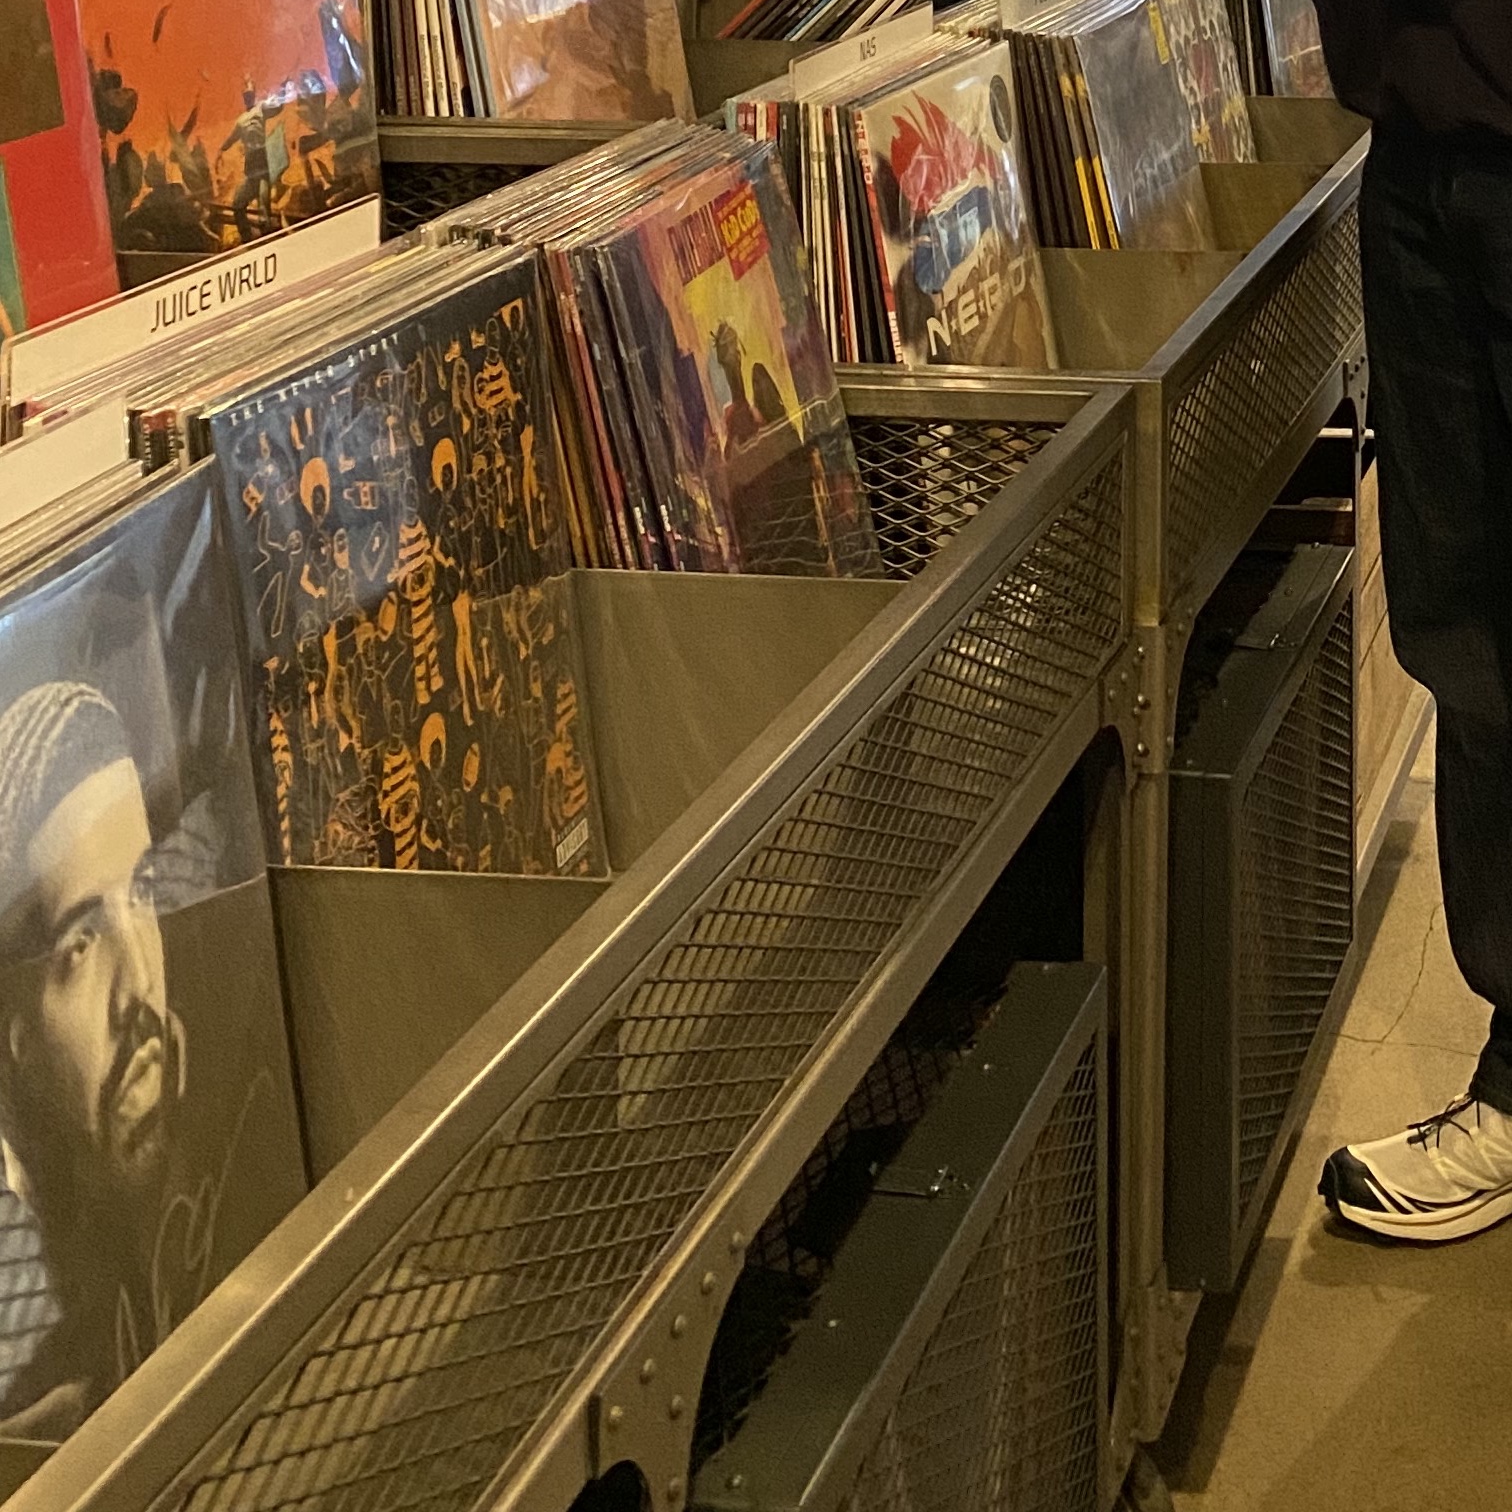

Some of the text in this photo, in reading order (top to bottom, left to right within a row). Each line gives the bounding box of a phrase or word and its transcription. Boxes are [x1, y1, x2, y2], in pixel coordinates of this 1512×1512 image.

[860, 37, 876, 62] NAS
[150, 252, 277, 333] JUICE WRLD
